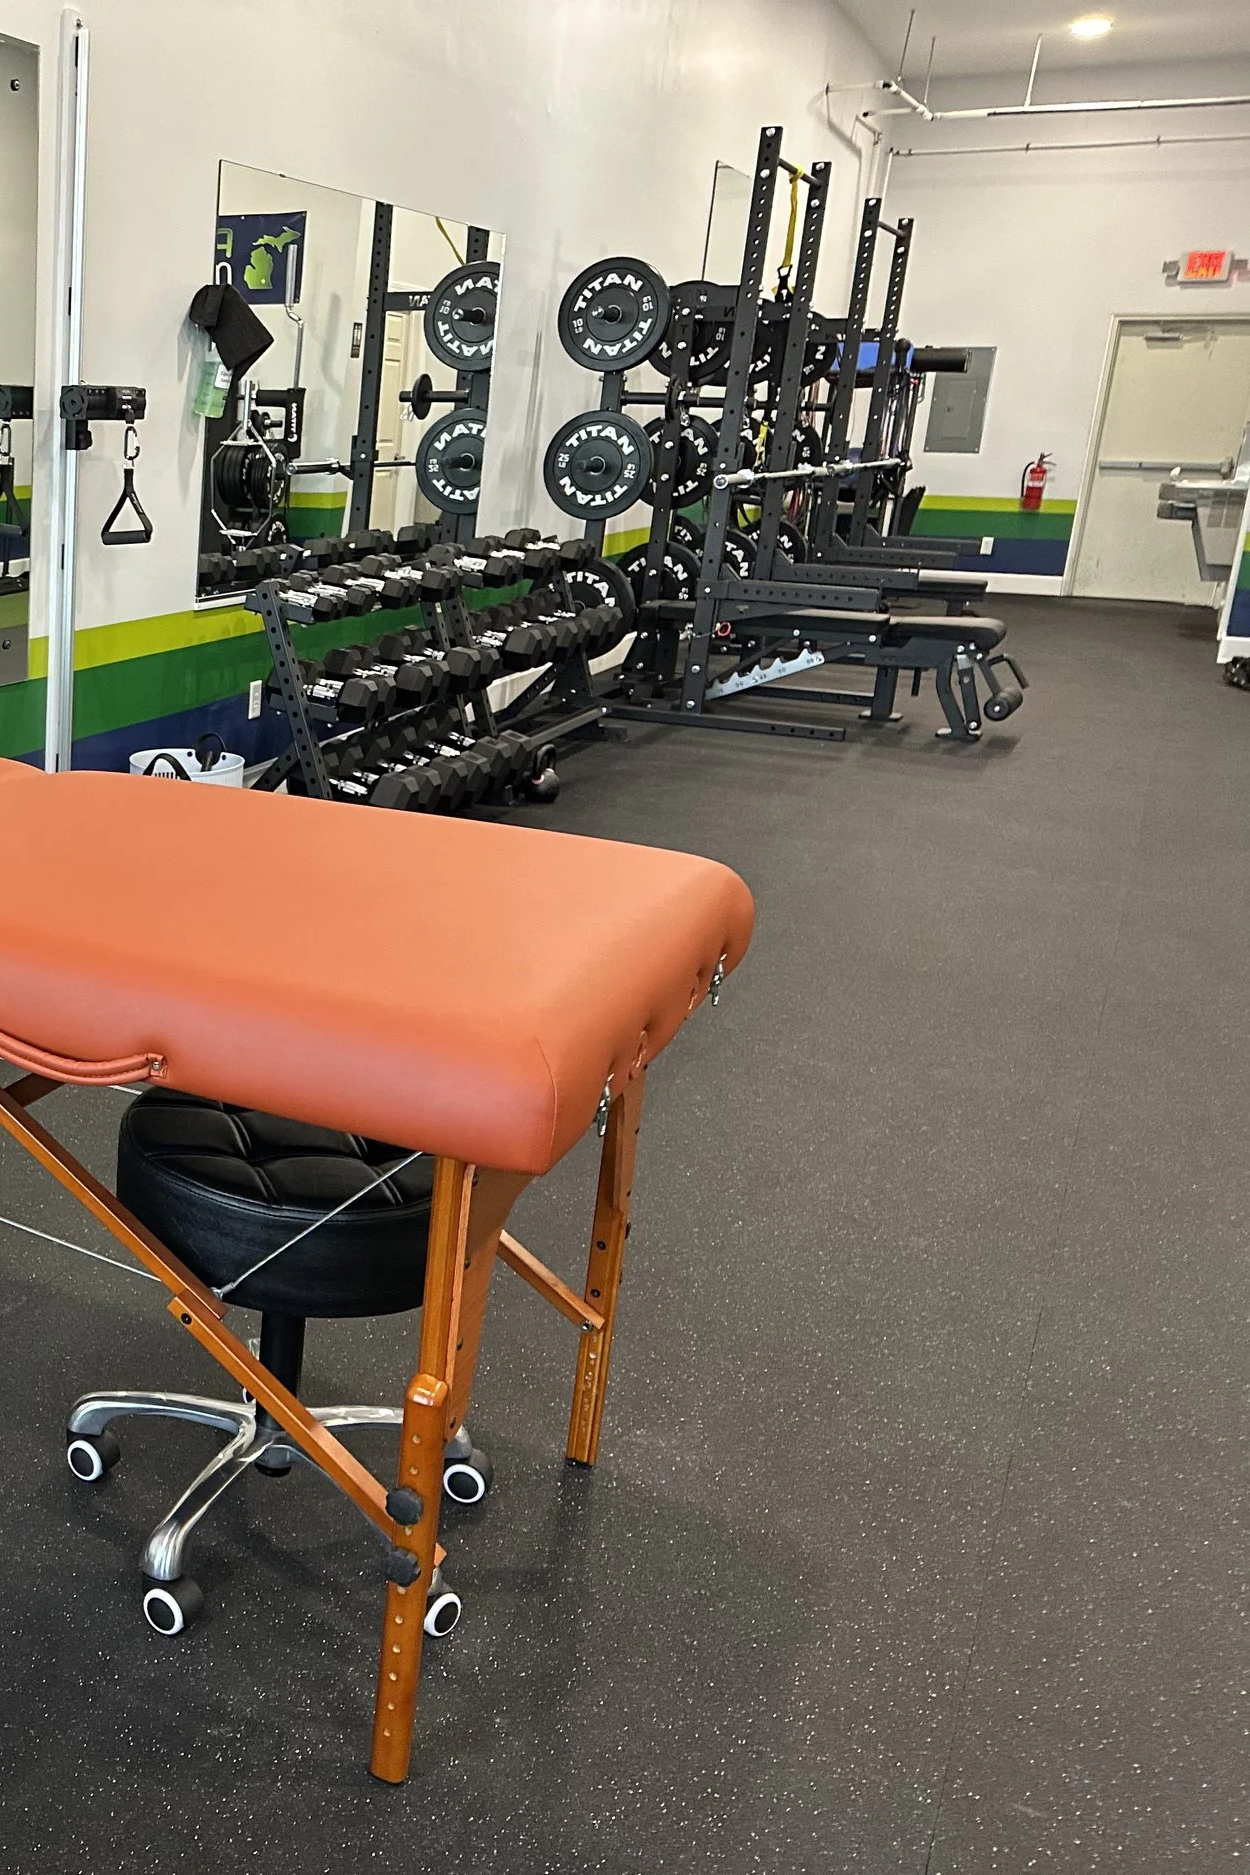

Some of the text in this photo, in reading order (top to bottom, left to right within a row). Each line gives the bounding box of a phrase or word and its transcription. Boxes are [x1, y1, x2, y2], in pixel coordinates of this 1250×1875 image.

[1184, 252, 1226, 279] EXIT
[573, 273, 644, 312] TITAN
[572, 318, 584, 328] 10
[582, 318, 653, 356] TITAN
[565, 425, 635, 456] TITAN
[558, 453, 570, 462] 25
[559, 476, 628, 507] TITAN
[628, 556, 689, 581] TIAN
